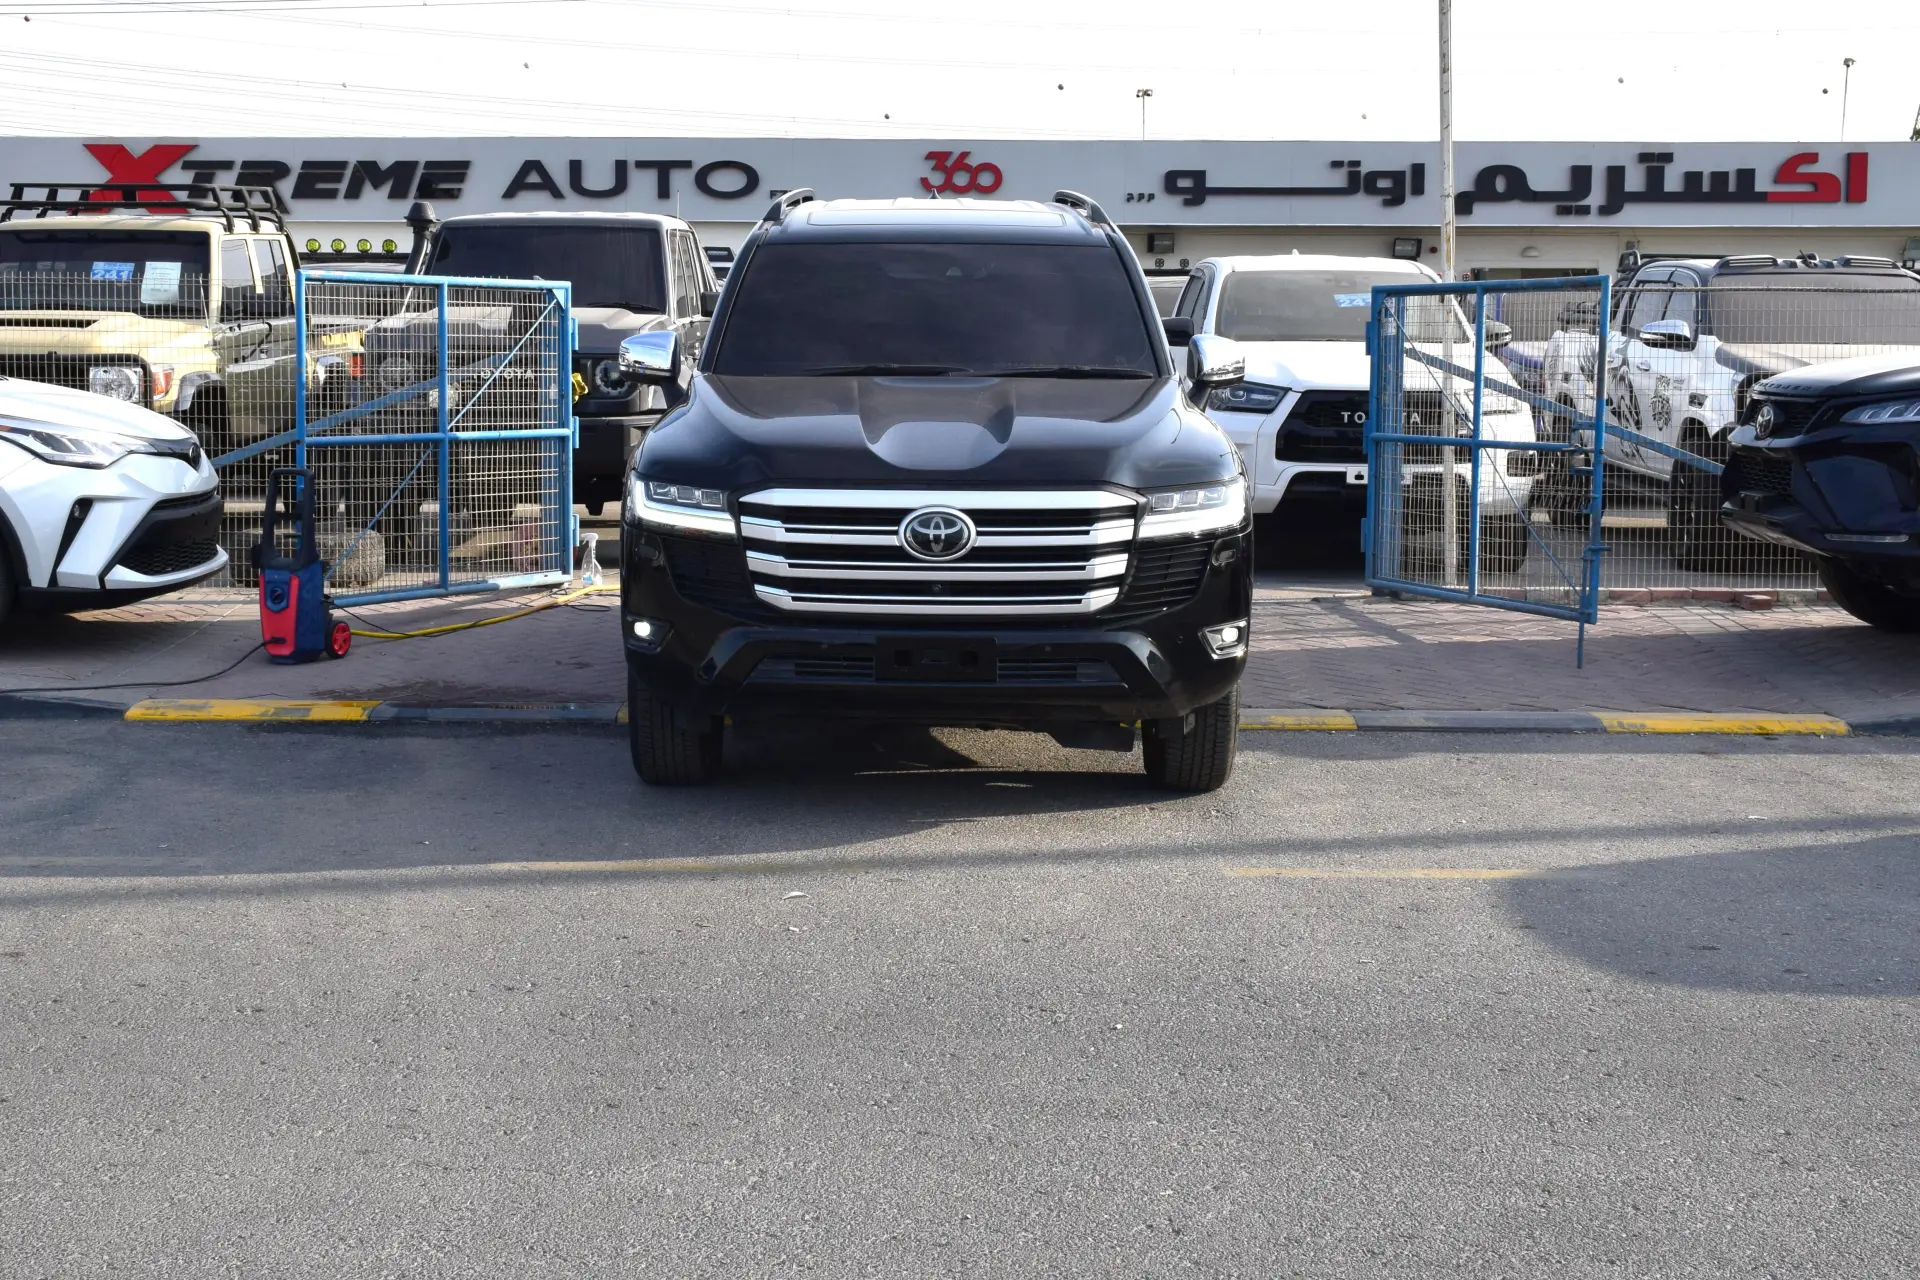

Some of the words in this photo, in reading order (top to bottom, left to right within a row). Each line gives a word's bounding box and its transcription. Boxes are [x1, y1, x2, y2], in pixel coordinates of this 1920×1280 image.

[69, 143, 471, 214] XTREME
[501, 159, 760, 199] AUTO
[920, 151, 1003, 194] 360
[1454, 152, 1868, 215] اكستريم
